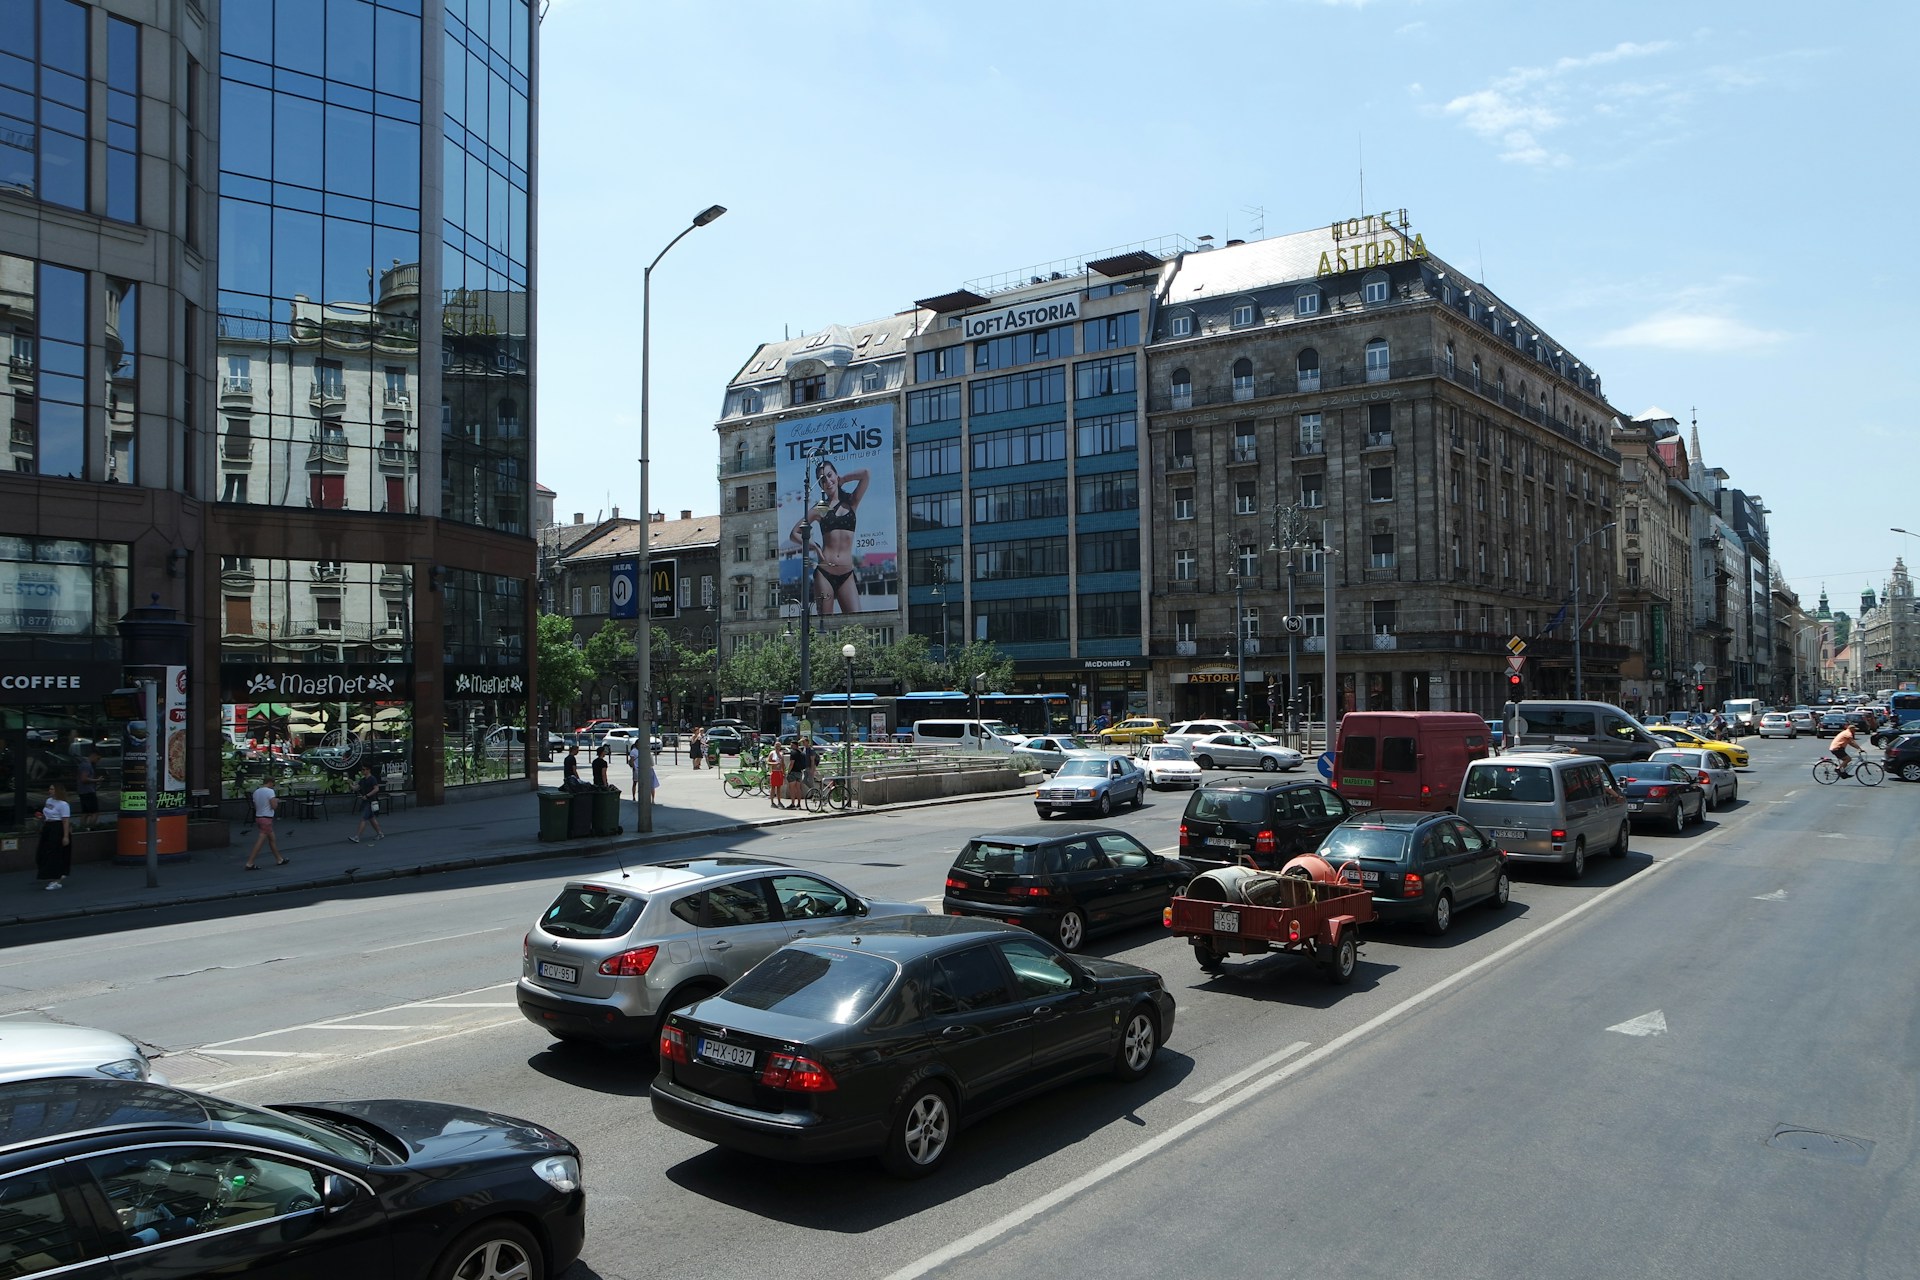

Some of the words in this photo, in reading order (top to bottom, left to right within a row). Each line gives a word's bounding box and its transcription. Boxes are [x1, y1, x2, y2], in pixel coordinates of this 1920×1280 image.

[1332, 208, 1410, 240] HOTEL
[1317, 233, 1428, 277] ASTORIA
[966, 317, 1003, 338] LOFT
[1004, 302, 1077, 330] ASTORIA
[856, 538, 875, 548] 3290
[28, 617, 48, 625] 877
[1085, 660, 1131, 668] McDonald's
[1, 676, 81, 689] COFFEE
[1219, 912, 1238, 922] XCH
[1220, 921, 1236, 931] 537
[543, 964, 575, 981] RCV-951
[705, 1041, 752, 1064] PHX-037
